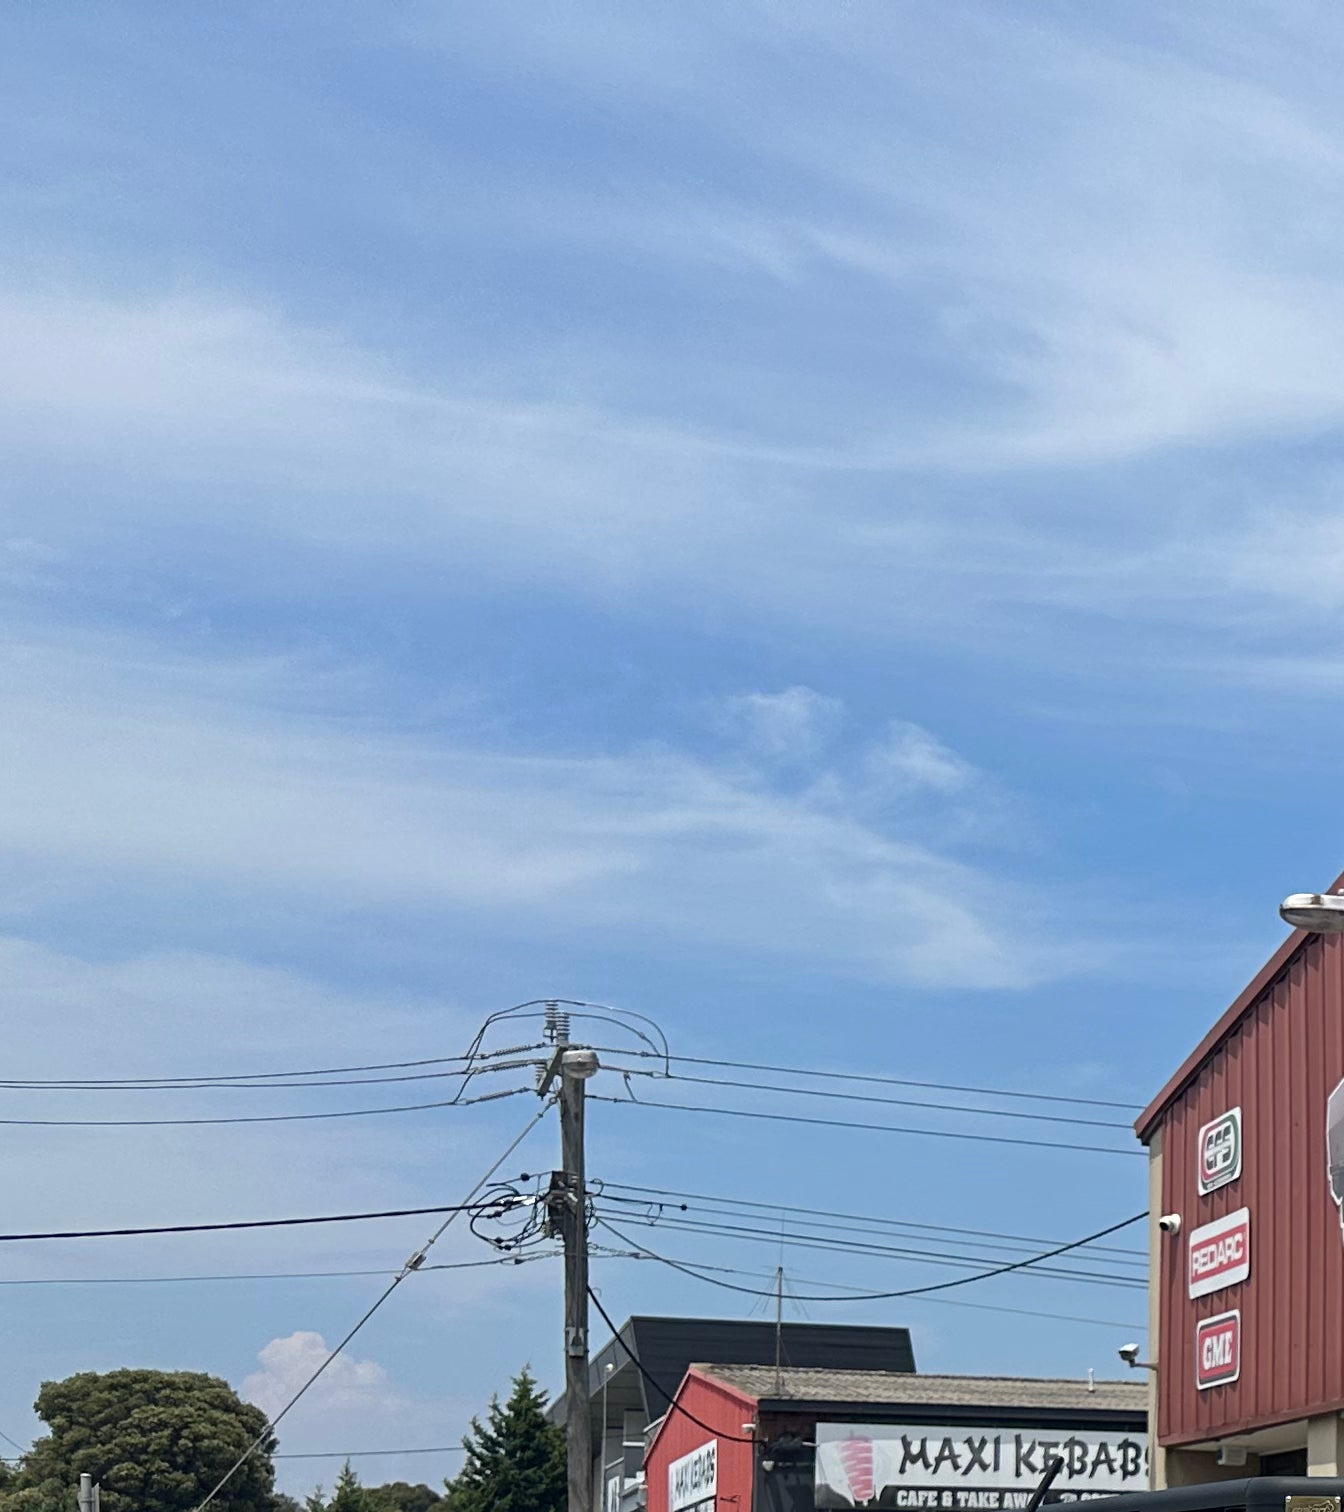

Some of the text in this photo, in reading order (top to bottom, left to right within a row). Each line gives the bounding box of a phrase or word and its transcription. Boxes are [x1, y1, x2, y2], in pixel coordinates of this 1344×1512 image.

[1191, 1232, 1244, 1276] REDARC
[1203, 1330, 1233, 1371] GME
[899, 1434, 1001, 1476] MAXI
[897, 1490, 938, 1508] CAFE
[957, 1491, 998, 1509] TAKE
